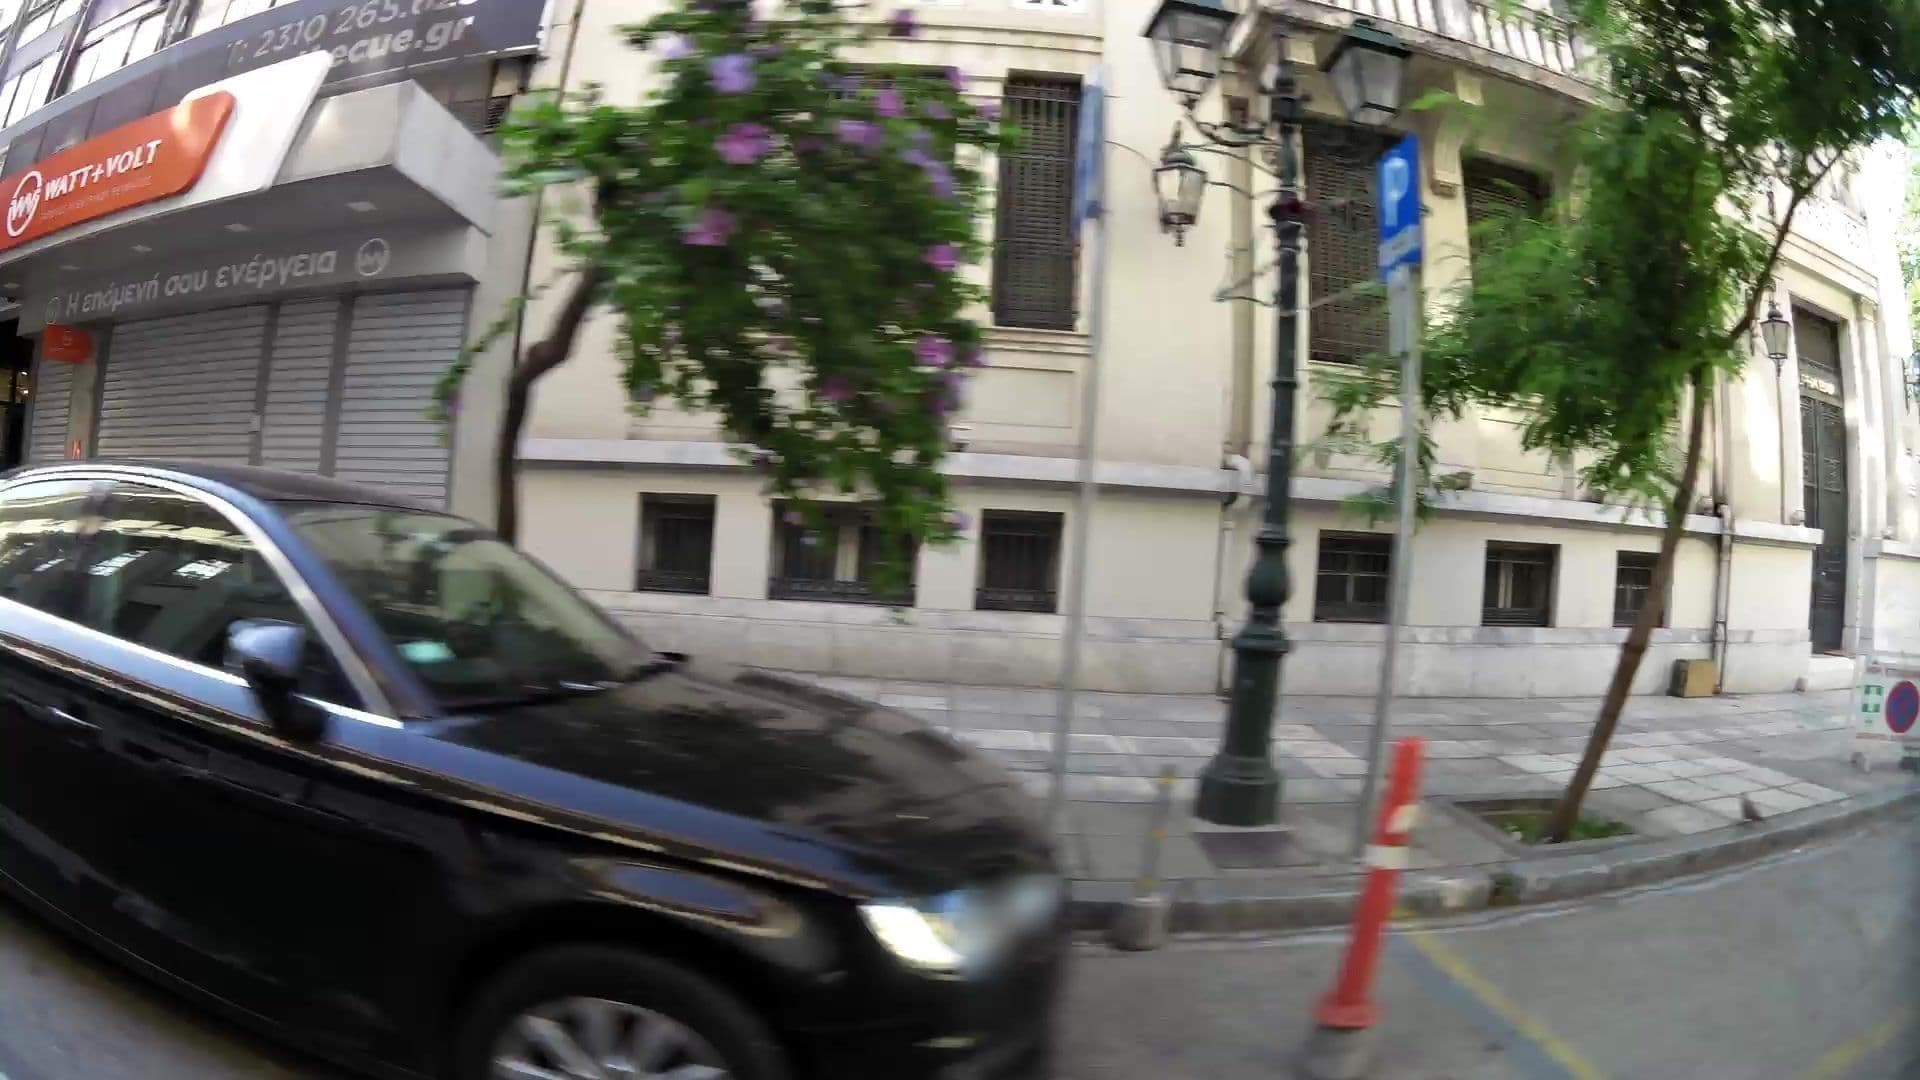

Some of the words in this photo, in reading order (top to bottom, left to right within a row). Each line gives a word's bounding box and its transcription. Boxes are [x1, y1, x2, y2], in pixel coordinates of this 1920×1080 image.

[253, 14, 328, 58] 2310
[299, 16, 476, 68] ecue.gr
[45, 139, 163, 201] WATT+VOLT
[1383, 156, 1410, 227] P
[164, 270, 209, 297] σου
[214, 250, 338, 289] ενέργεια
